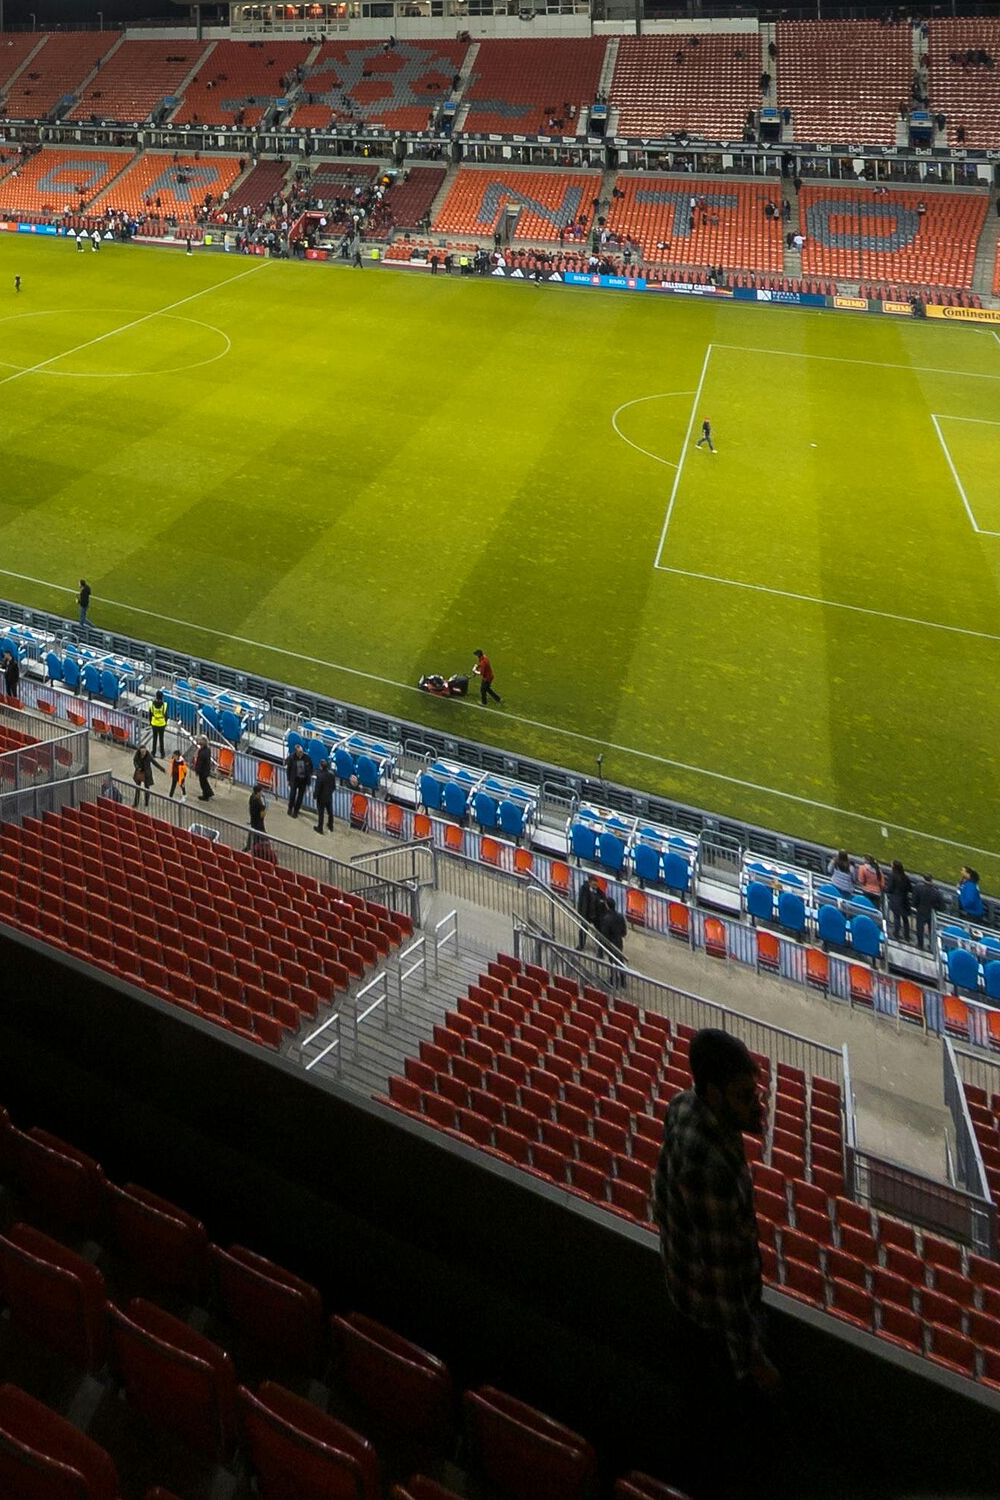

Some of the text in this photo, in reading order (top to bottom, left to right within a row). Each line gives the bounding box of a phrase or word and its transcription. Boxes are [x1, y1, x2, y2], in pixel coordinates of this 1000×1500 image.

[816, 144, 832, 152] Bell
[849, 145, 864, 153] Bell
[915, 148, 932, 156] Bell
[950, 149, 968, 158] Bell
[609, 278, 626, 286] BMO
[661, 281, 693, 290] FALLSVIEW
[693, 284, 716, 292] CASINO
[836, 298, 866, 308] PRIMO
